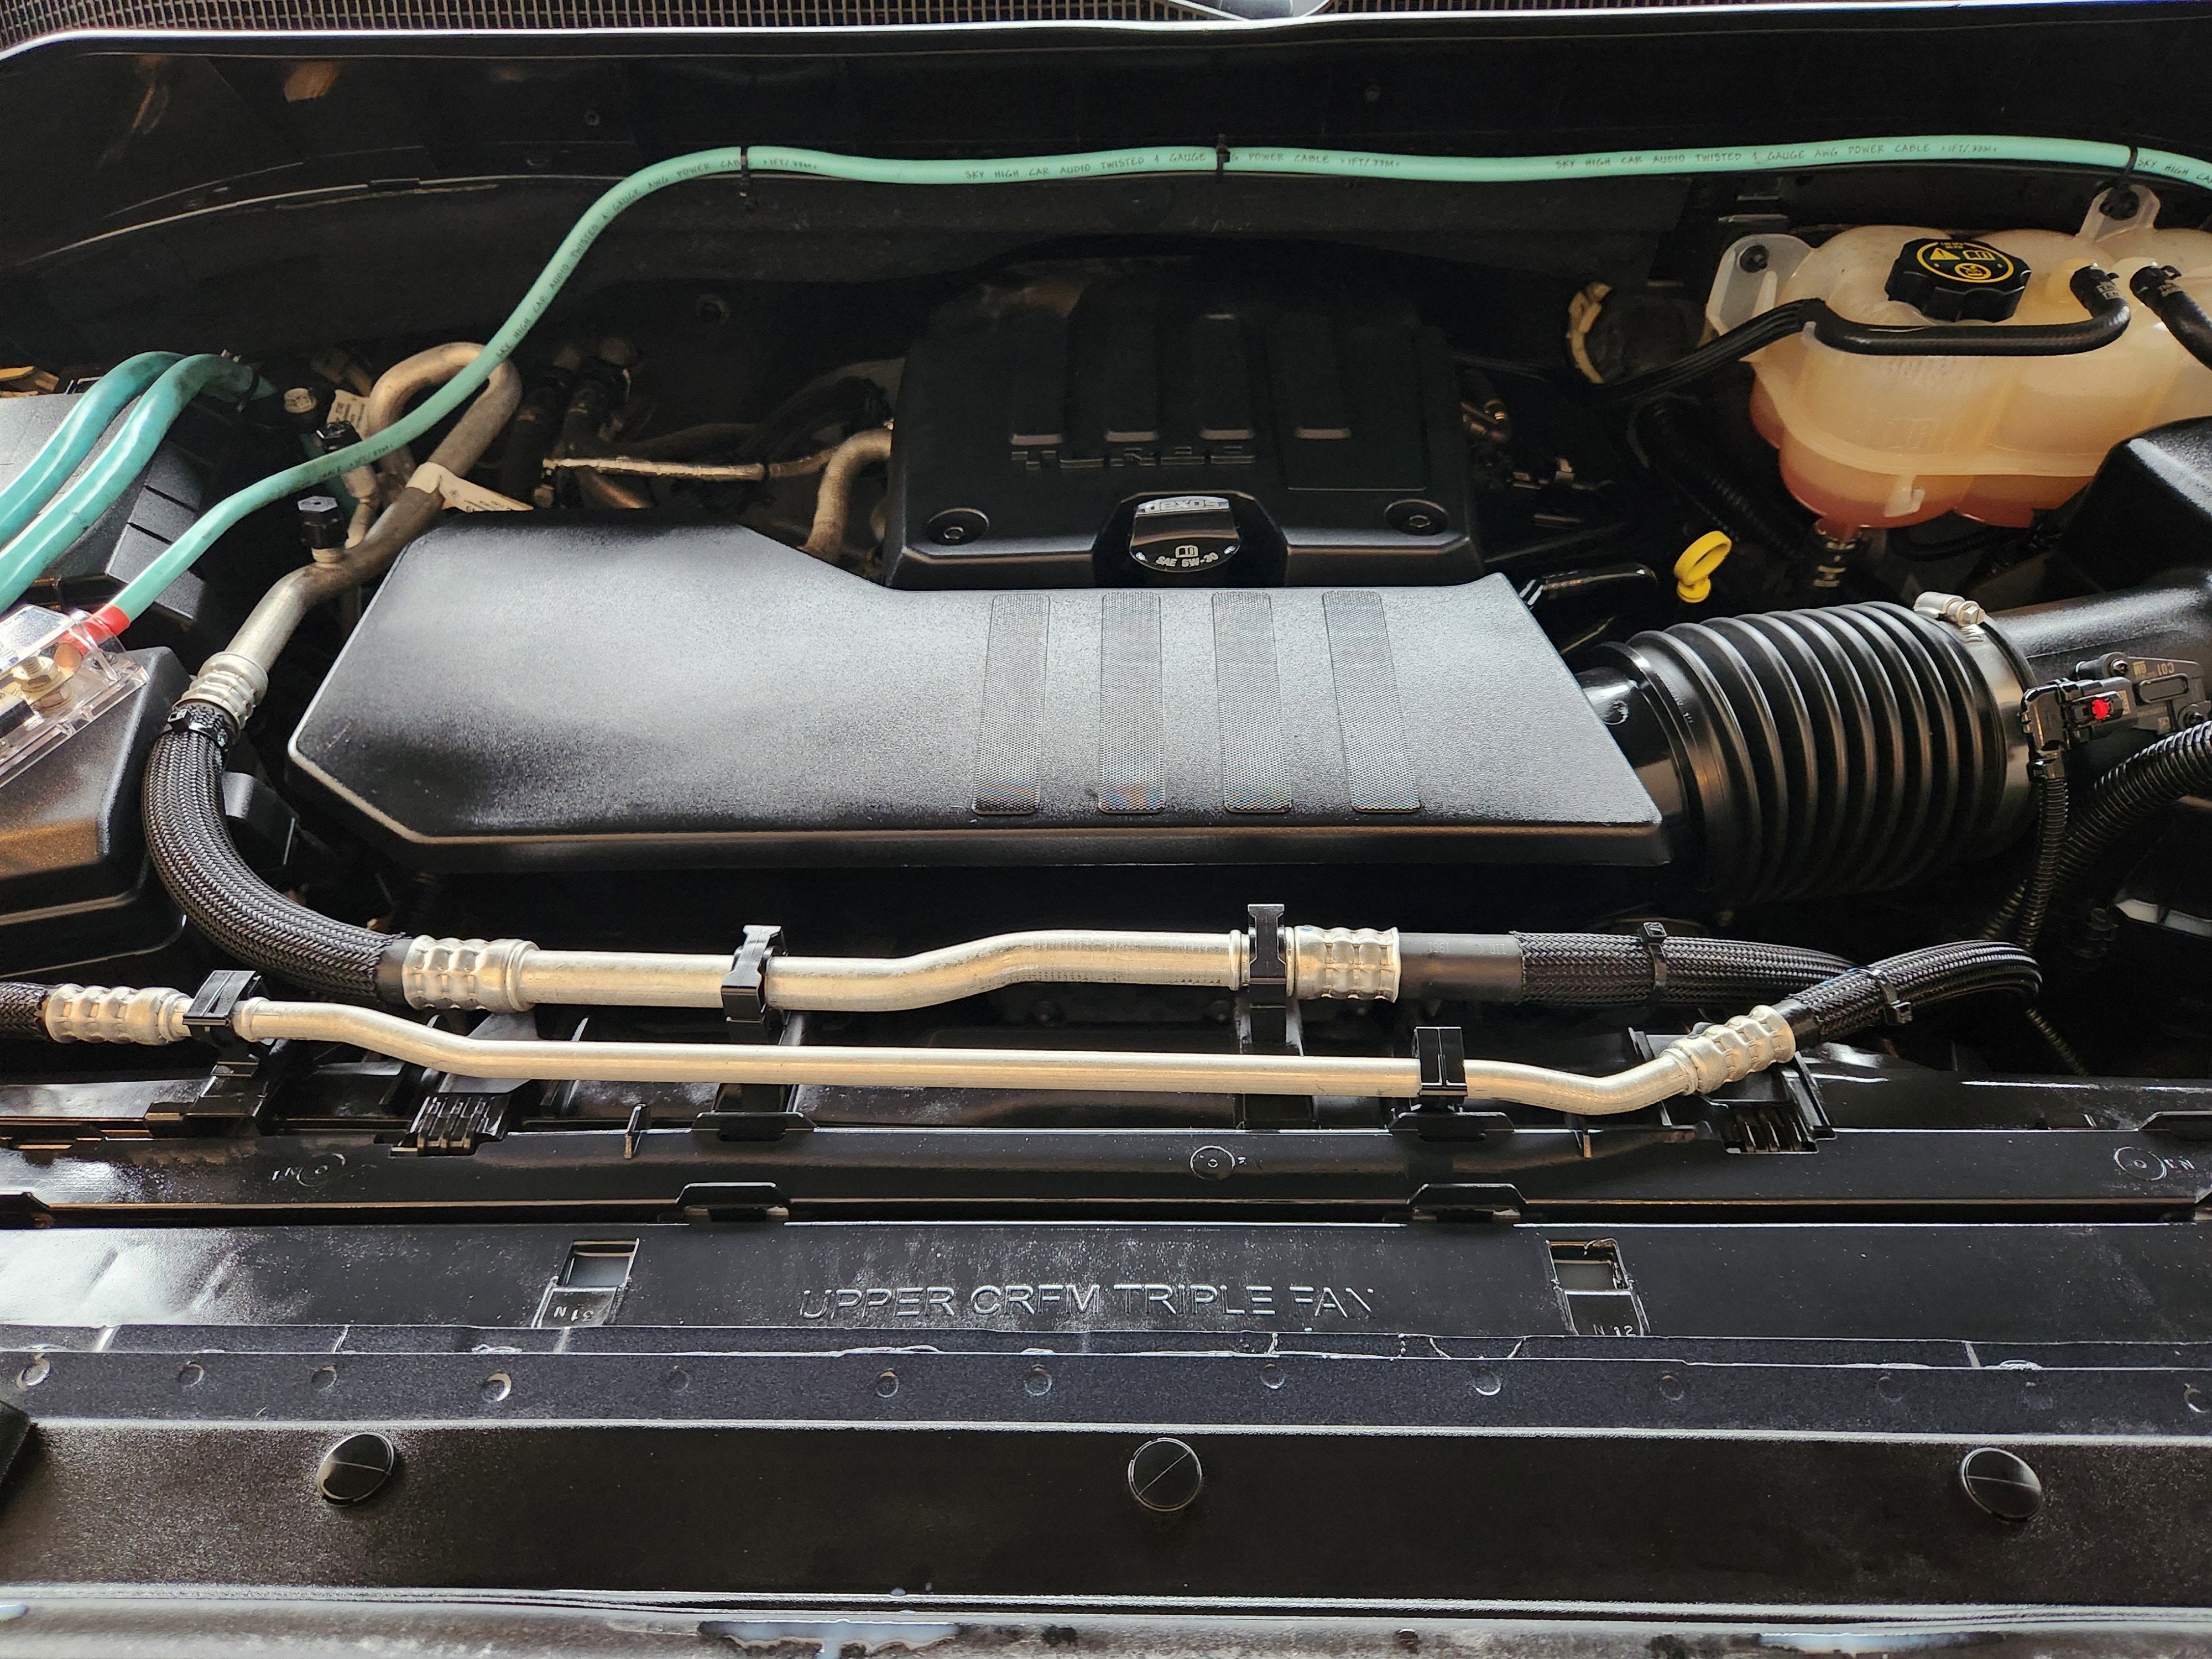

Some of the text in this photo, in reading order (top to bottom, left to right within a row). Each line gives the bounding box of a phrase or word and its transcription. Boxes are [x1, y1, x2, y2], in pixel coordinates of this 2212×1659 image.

[1294, 155, 1328, 164] CABLE
[1555, 160, 1575, 169] SKY
[1621, 155, 1641, 164] CAR
[1653, 154, 1685, 164] AUDIO
[1695, 153, 1741, 161] TWISTED
[1767, 151, 1804, 160] GAUGE
[1814, 148, 1838, 158] AWG
[1849, 144, 1884, 154] POWER
[1895, 144, 1929, 153] CABLE
[965, 170, 984, 179] SKY
[1029, 167, 1048, 176] CAR
[1060, 164, 1091, 174] AUDIO
[1101, 156, 1143, 169] TWISTED
[1169, 154, 1205, 162] GAUGE
[2164, 165, 2189, 176] HIGH
[533, 294, 549, 314] CAR
[549, 263, 570, 290] AUDIO
[676, 163, 709, 180] POWER
[1145, 499, 1219, 513] dexos
[1156, 552, 1219, 567] SAE 5W-30
[2132, 660, 2147, 675] GM
[800, 1284, 1374, 1319] UPPER CRFM TRIPLE FAN
